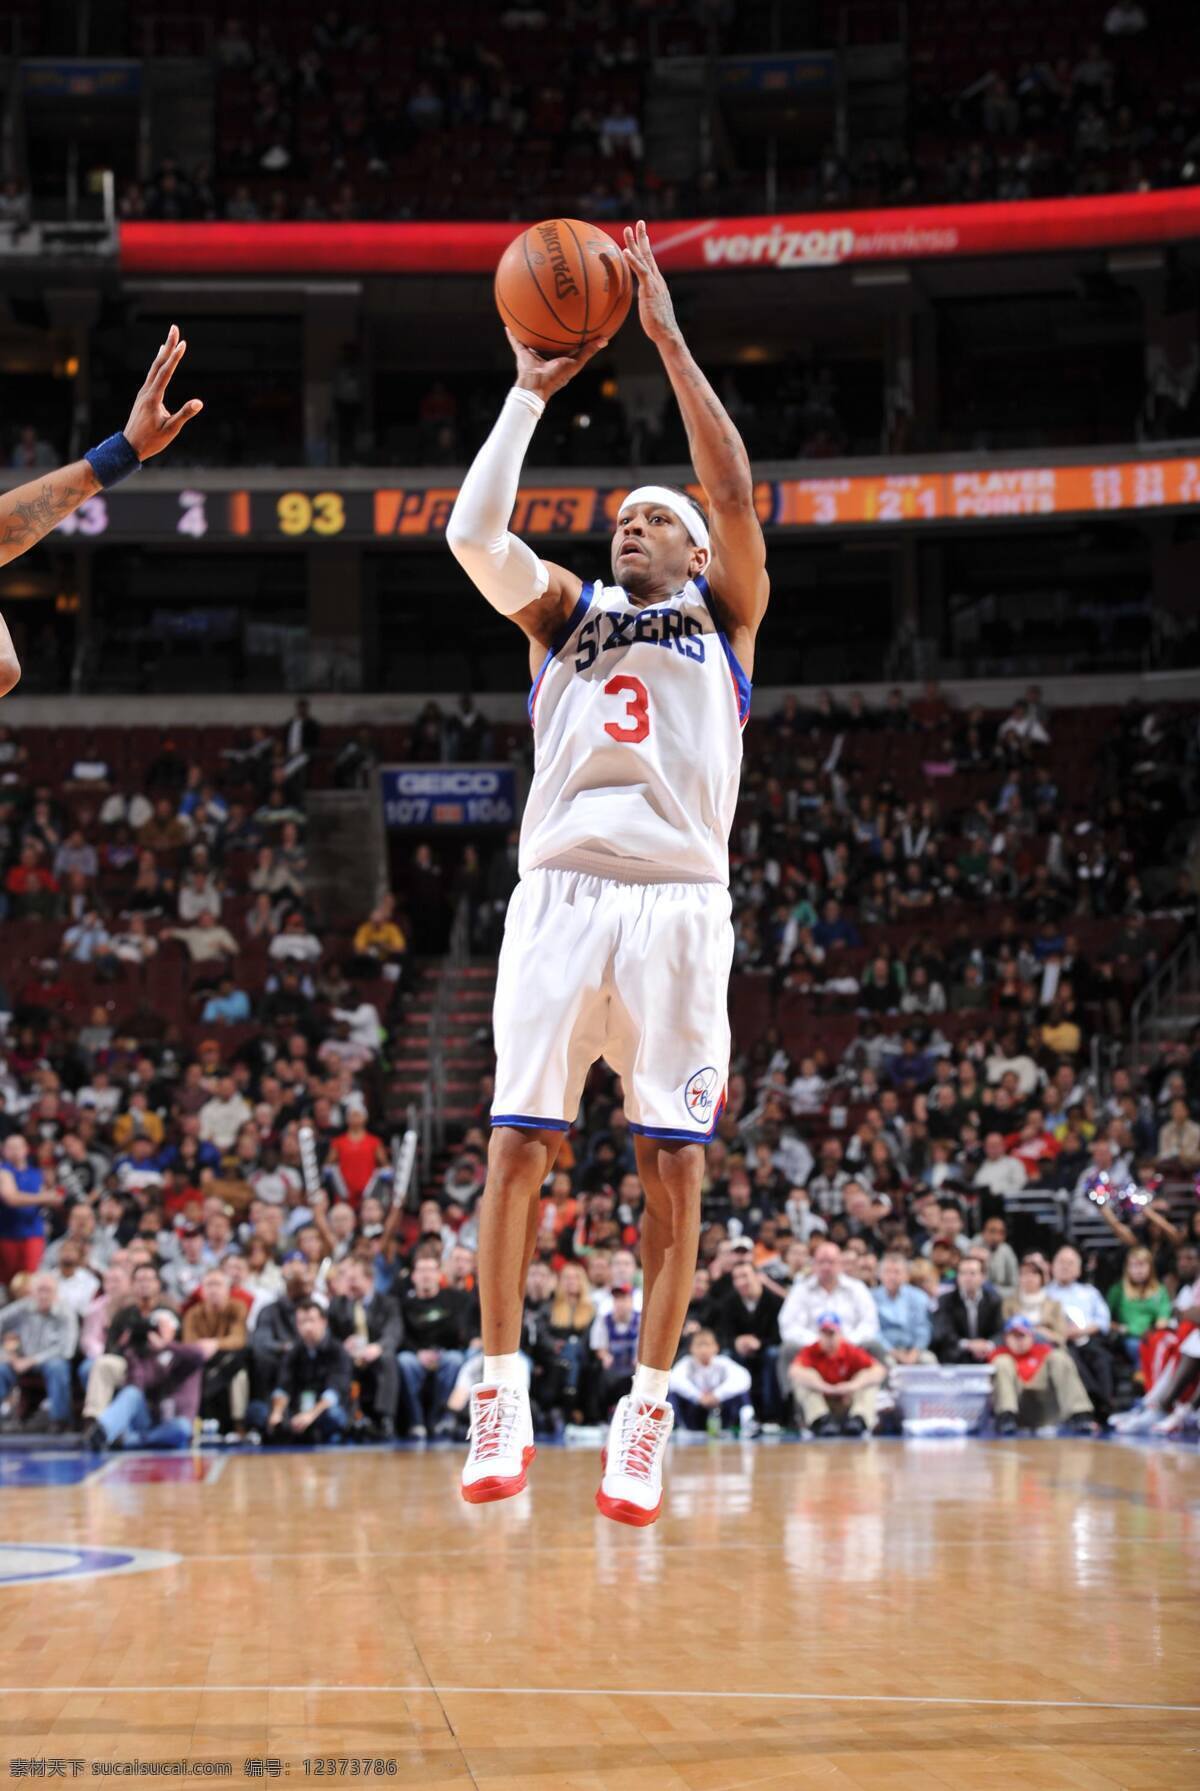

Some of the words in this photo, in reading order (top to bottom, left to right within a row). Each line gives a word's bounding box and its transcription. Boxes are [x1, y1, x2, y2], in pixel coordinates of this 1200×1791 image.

[536, 221, 580, 300] SPALDING
[704, 224, 854, 268] verizon
[855, 227, 958, 252] wireless
[277, 492, 346, 535] 93
[575, 608, 705, 672] SIXERS
[604, 675, 650, 743] 3
[397, 772, 499, 796] GEICO
